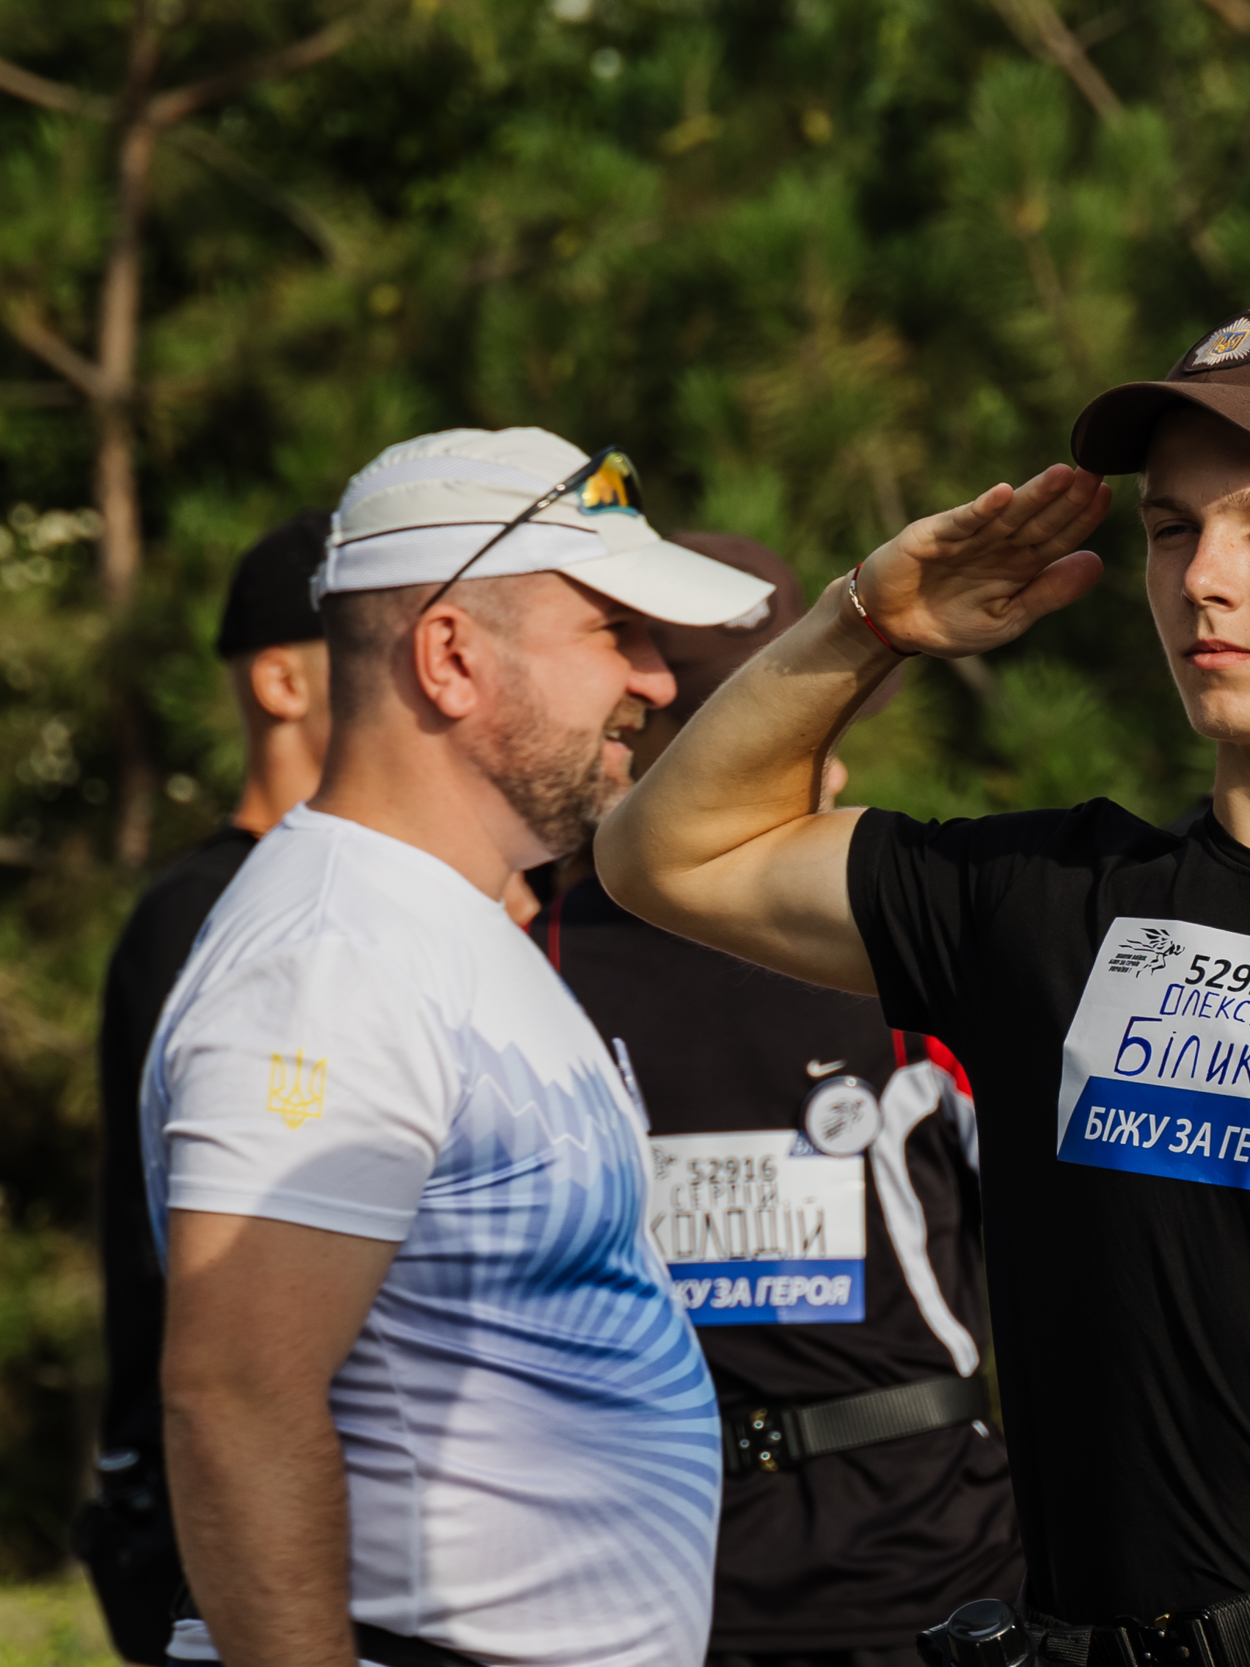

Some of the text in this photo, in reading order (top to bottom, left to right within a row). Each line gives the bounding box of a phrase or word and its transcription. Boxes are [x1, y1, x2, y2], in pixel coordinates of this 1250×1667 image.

[1084, 1106, 1171, 1149] БІЖУ
[1168, 1118, 1212, 1157] ЗА
[688, 1155, 777, 1185] 52916
[710, 1276, 751, 1308] ЗА
[754, 1275, 852, 1307] ГЕРОЯ
